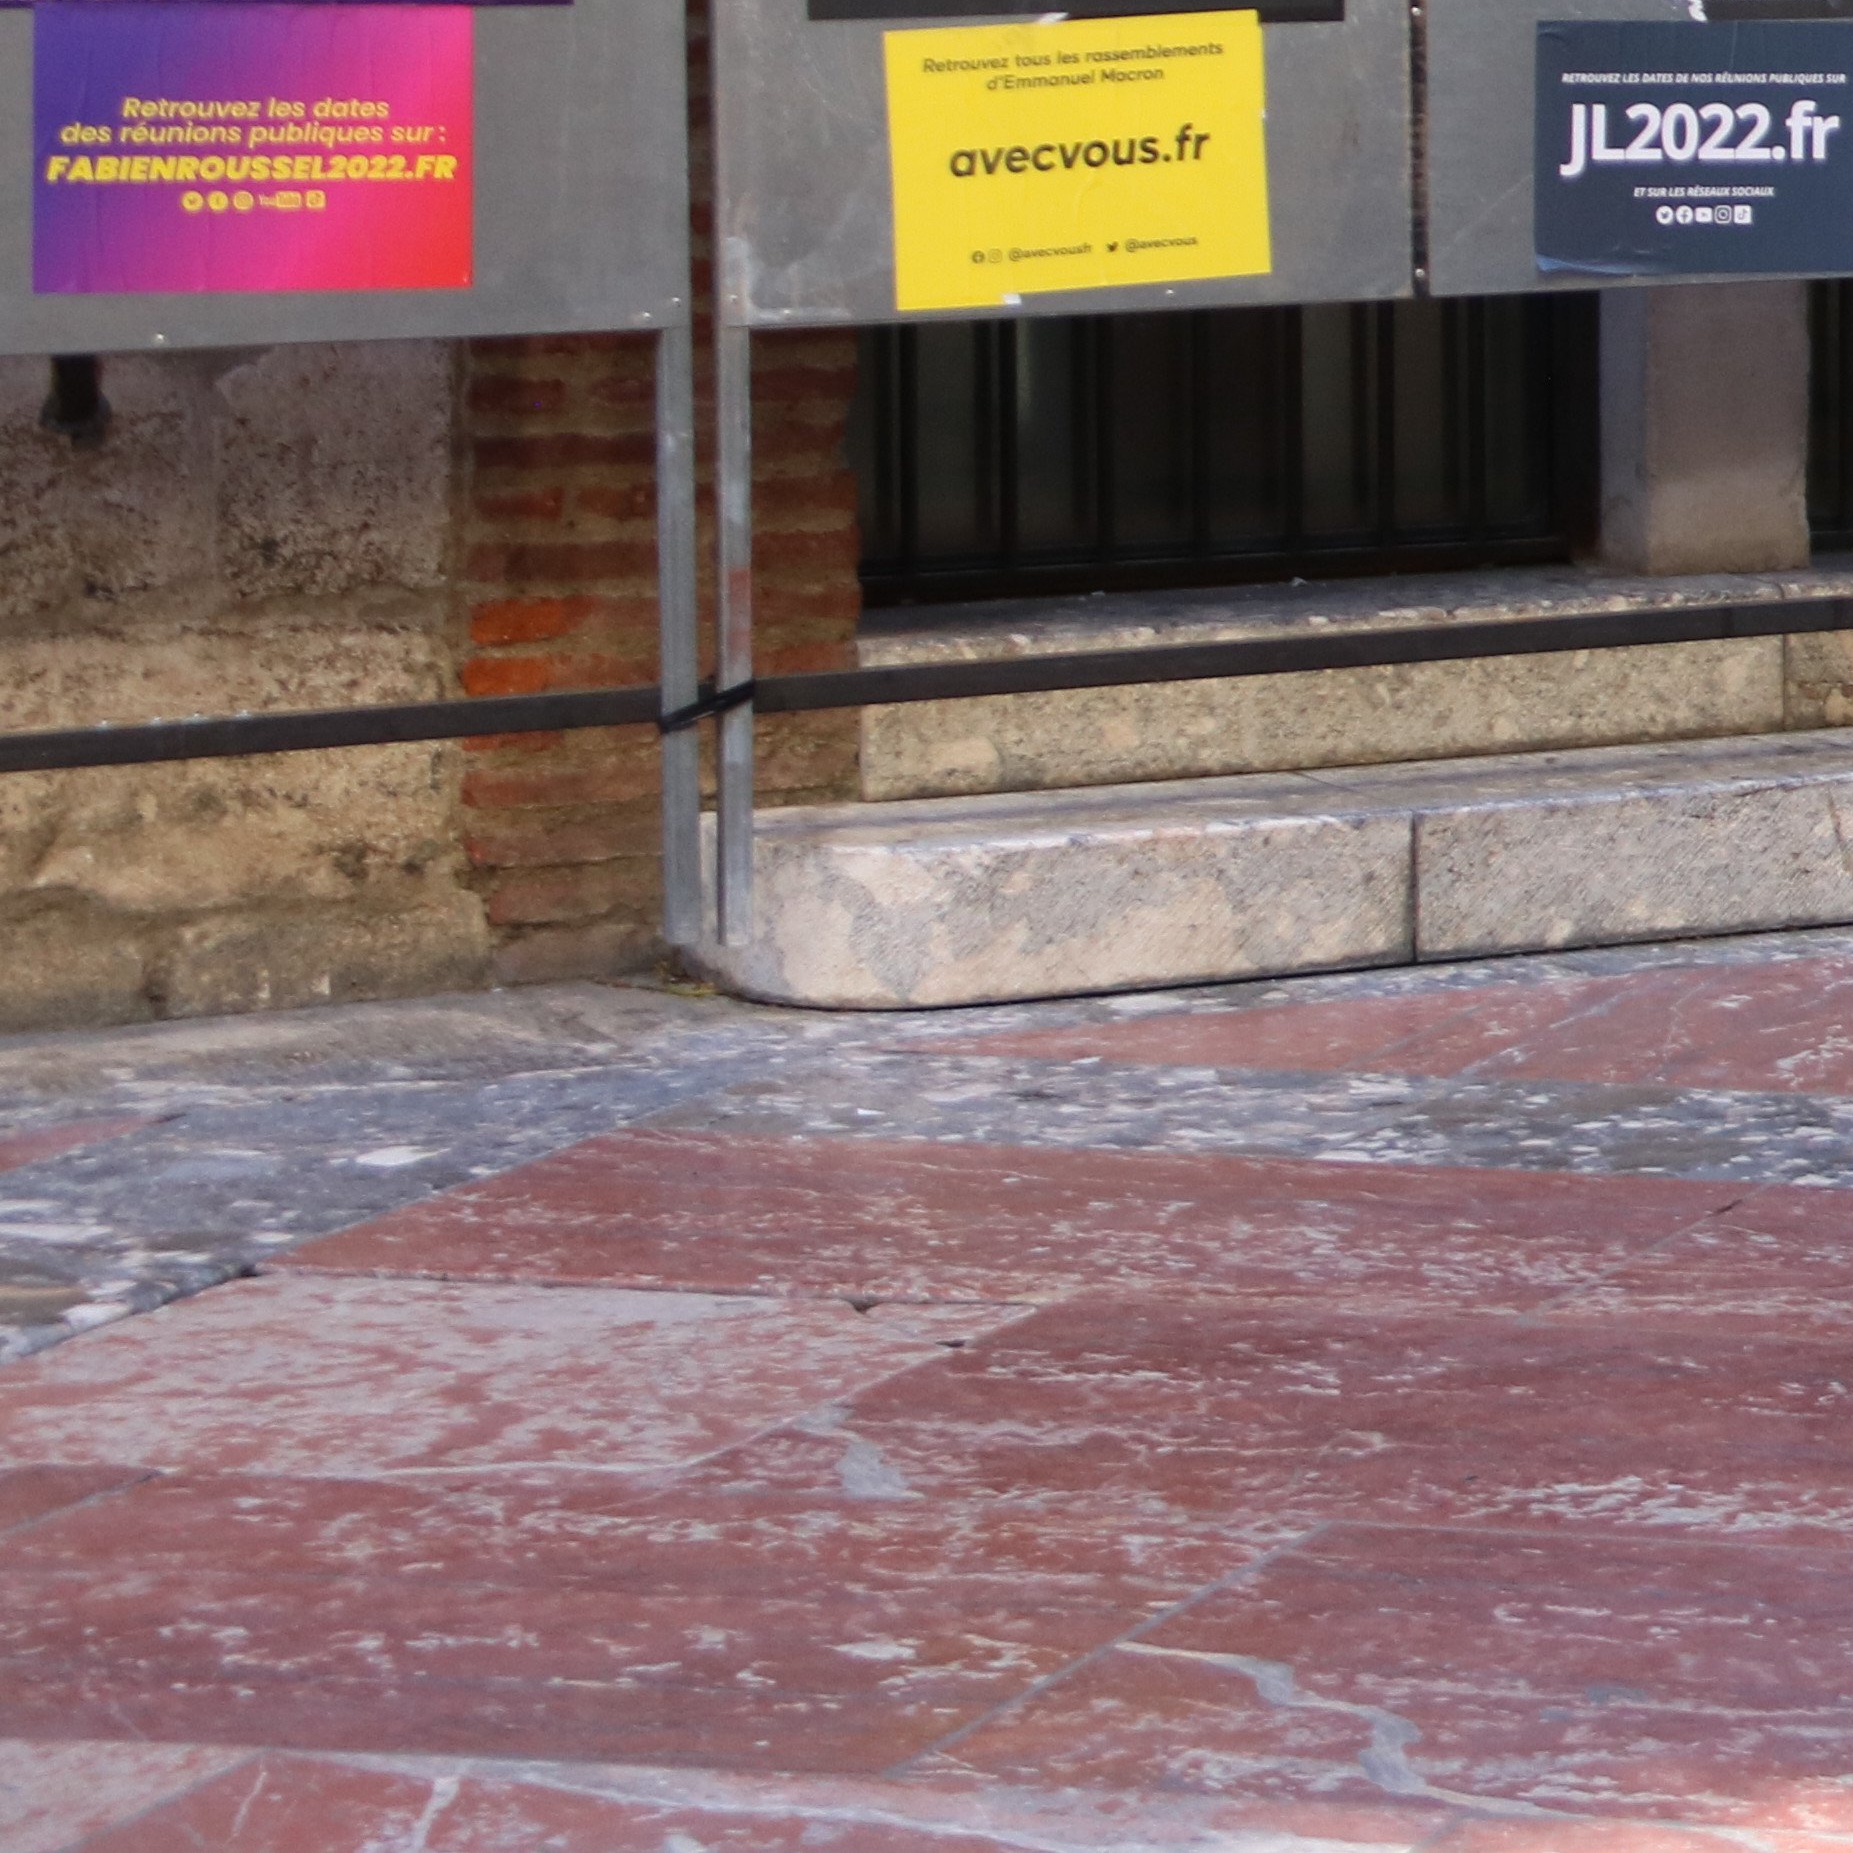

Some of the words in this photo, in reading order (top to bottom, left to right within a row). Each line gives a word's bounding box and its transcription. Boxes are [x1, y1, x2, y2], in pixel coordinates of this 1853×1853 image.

[922, 56, 1009, 73] Retrouvez
[1015, 53, 1051, 67] tous
[1056, 50, 1079, 64] les
[1085, 42, 1224, 63] rassemblements
[987, 70, 1095, 91] d'Emmanuel
[1101, 67, 1164, 83] Macron
[1562, 73, 1620, 84] RETROUVEZ
[1622, 73, 1640, 84] LES
[1642, 73, 1673, 84] DATES
[1676, 73, 1689, 84] DE
[1691, 73, 1712, 84] NOS
[1715, 71, 1767, 84] RÉUNIONS
[1769, 73, 1824, 85] PUBLIQUES
[1826, 73, 1846, 84] SUR
[122, 98, 262, 119] Retrouvez
[267, 97, 305, 119] les
[313, 97, 390, 118] dates
[61, 122, 111, 144] des
[120, 121, 242, 144] réunions
[248, 121, 383, 148] publiques
[391, 126, 433, 143] sur
[1559, 99, 1841, 177] JL2022.fr
[950, 123, 1210, 178] avecvous.fr
[47, 155, 458, 182] FABIENROUSSEL2022.FR
[1634, 187, 1646, 197] ET
[1647, 187, 1667, 197] SUR
[1668, 187, 1685, 197] LES
[1731, 186, 1775, 197] SOCIAUX
